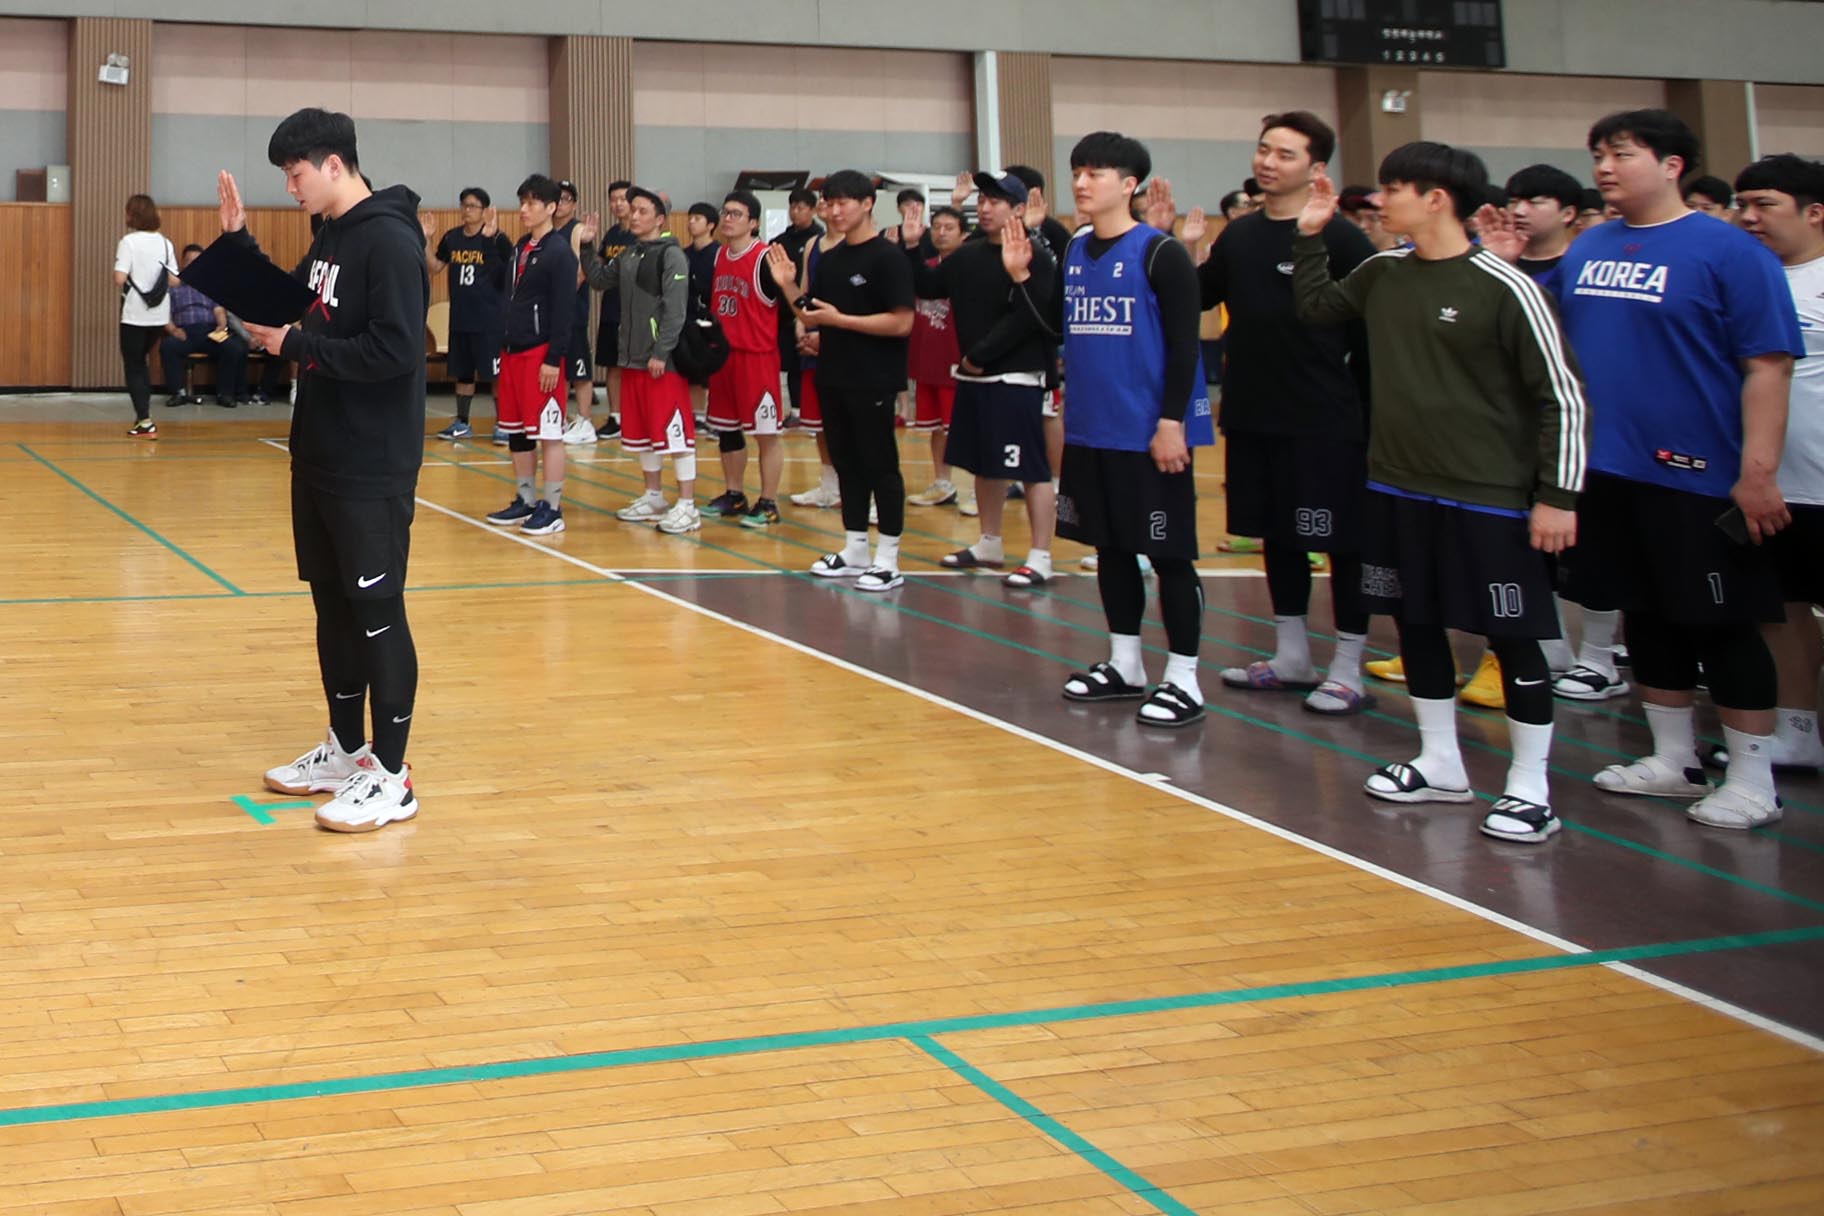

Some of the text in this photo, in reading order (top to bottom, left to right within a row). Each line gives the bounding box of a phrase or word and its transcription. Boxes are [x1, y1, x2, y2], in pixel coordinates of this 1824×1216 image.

[459, 264, 475, 285] 13
[1112, 261, 1124, 278] 2
[1577, 259, 1669, 294] KOREA
[717, 294, 738, 317] 30
[546, 409, 560, 425] 17
[760, 404, 777, 419] 30
[671, 423, 682, 438] 3
[1004, 444, 1020, 468] 3
[1150, 511, 1167, 541] 2
[1296, 507, 1332, 537] 93
[1706, 572, 1725, 605] 1
[1489, 582, 1524, 619] 10
